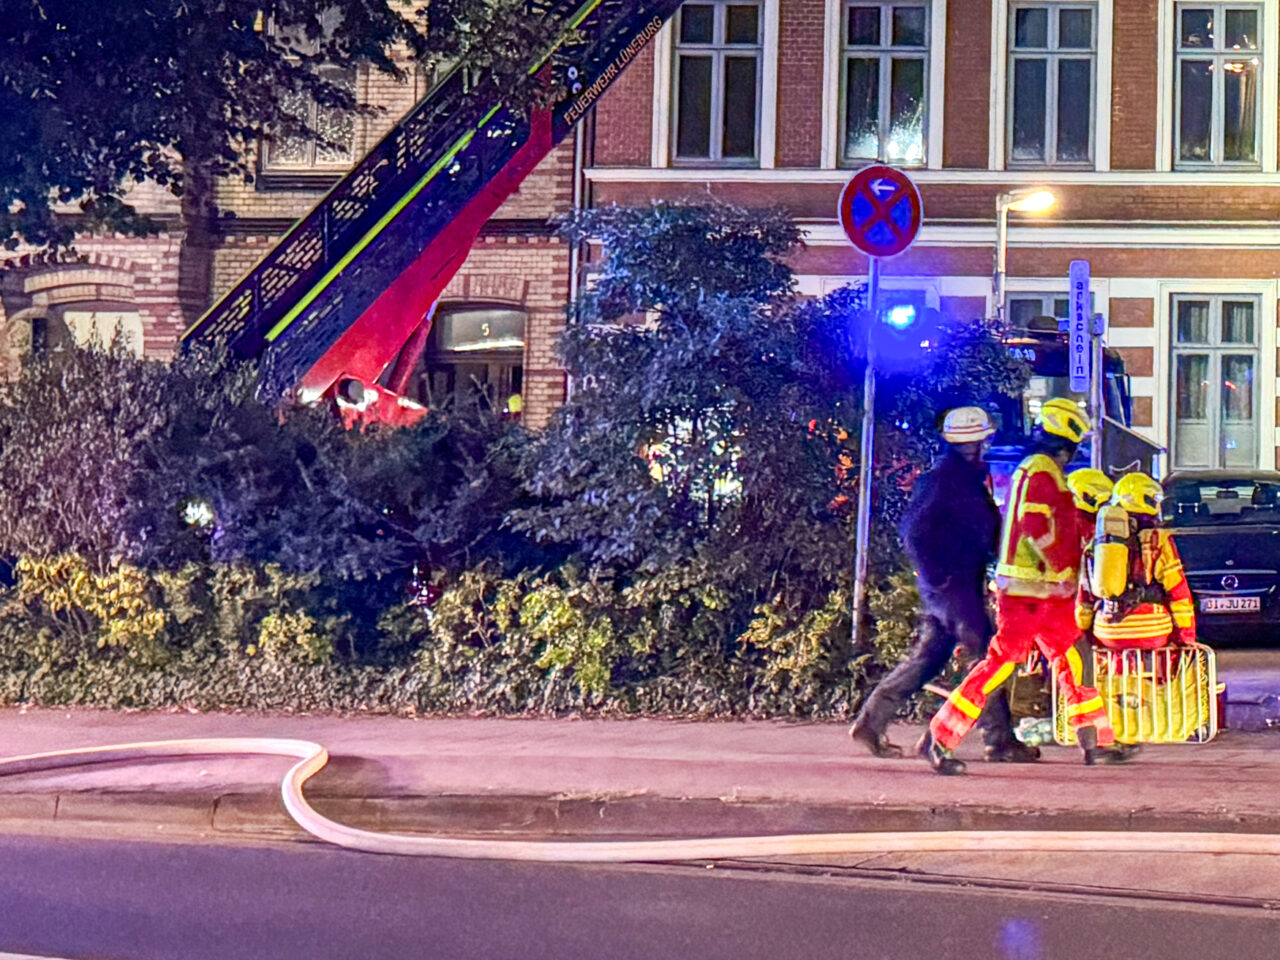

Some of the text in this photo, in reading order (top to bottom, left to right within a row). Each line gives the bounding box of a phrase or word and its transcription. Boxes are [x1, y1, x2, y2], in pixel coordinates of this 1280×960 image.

[564, 64, 618, 125] FEUERWEHR
[481, 322, 490, 337] 5
[1241, 599, 1258, 609] 271
